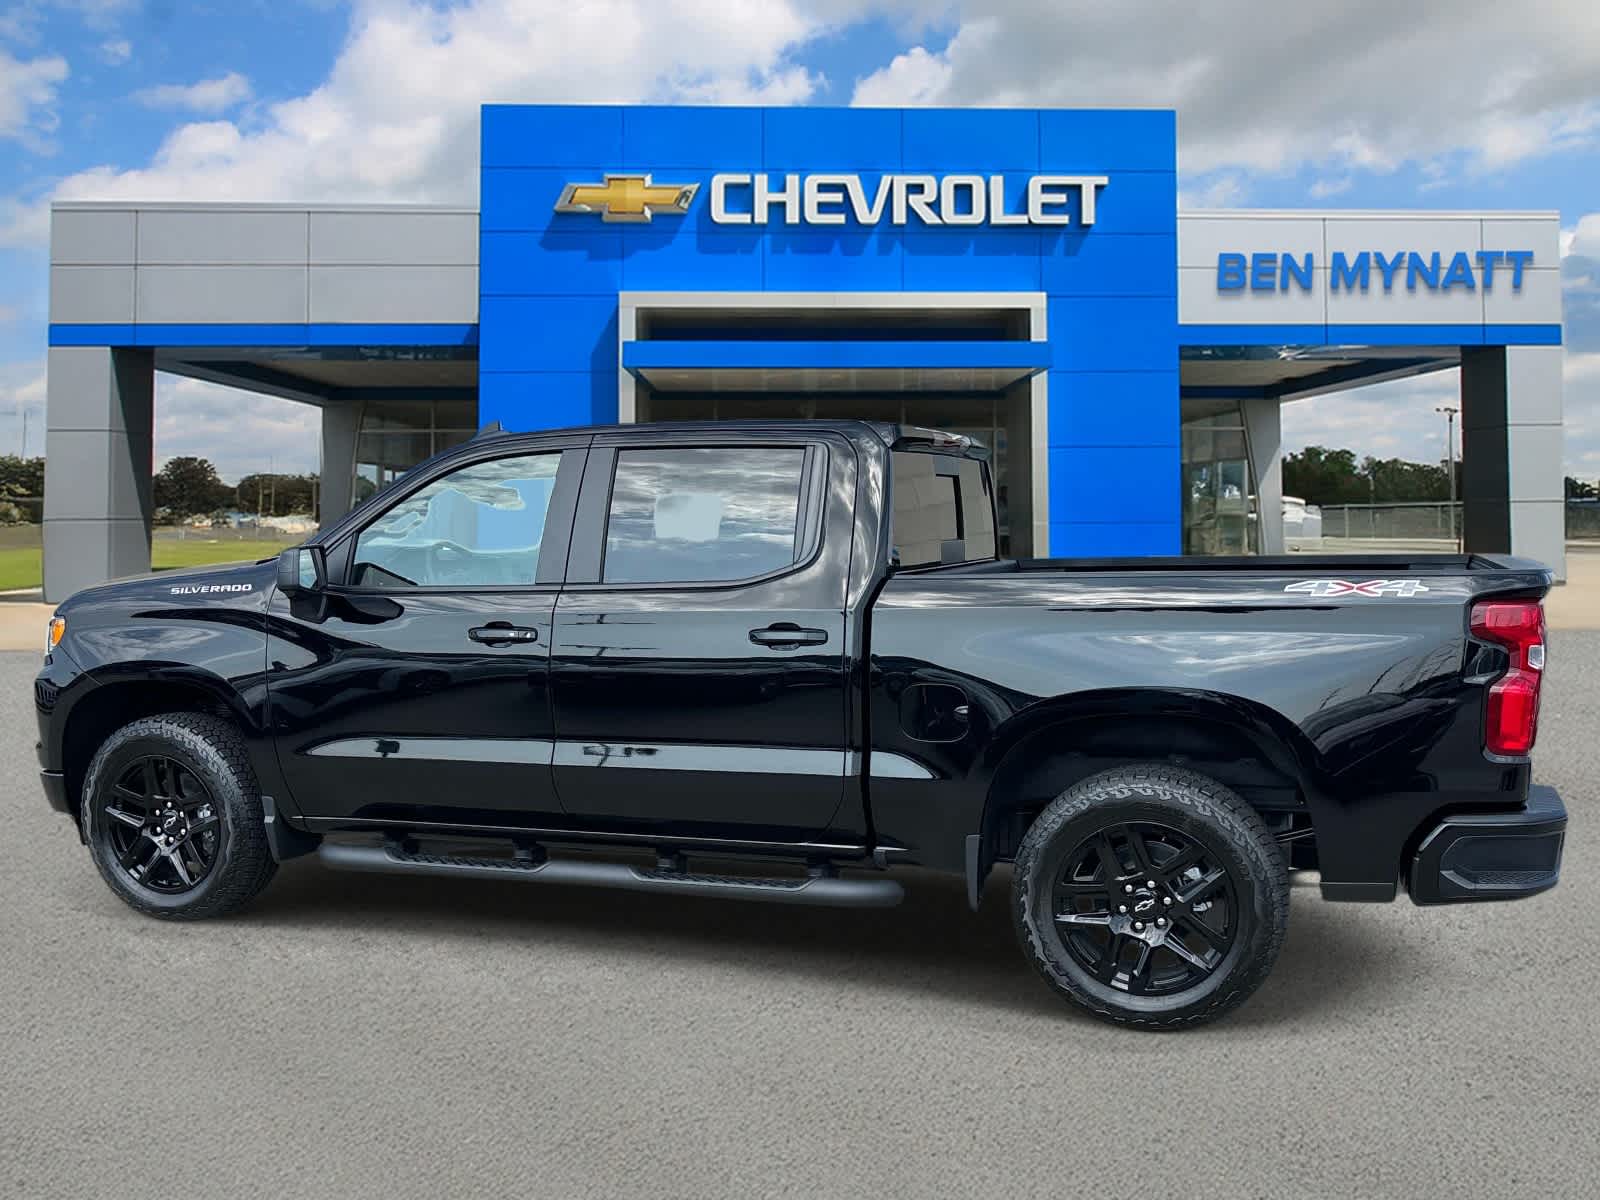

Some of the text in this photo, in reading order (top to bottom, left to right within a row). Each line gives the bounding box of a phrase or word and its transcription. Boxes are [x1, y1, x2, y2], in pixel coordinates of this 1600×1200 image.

[710, 173, 1109, 225] CHEVROLET
[1217, 251, 1534, 291] BEN MYNATT
[170, 583, 252, 595] SILVERADO
